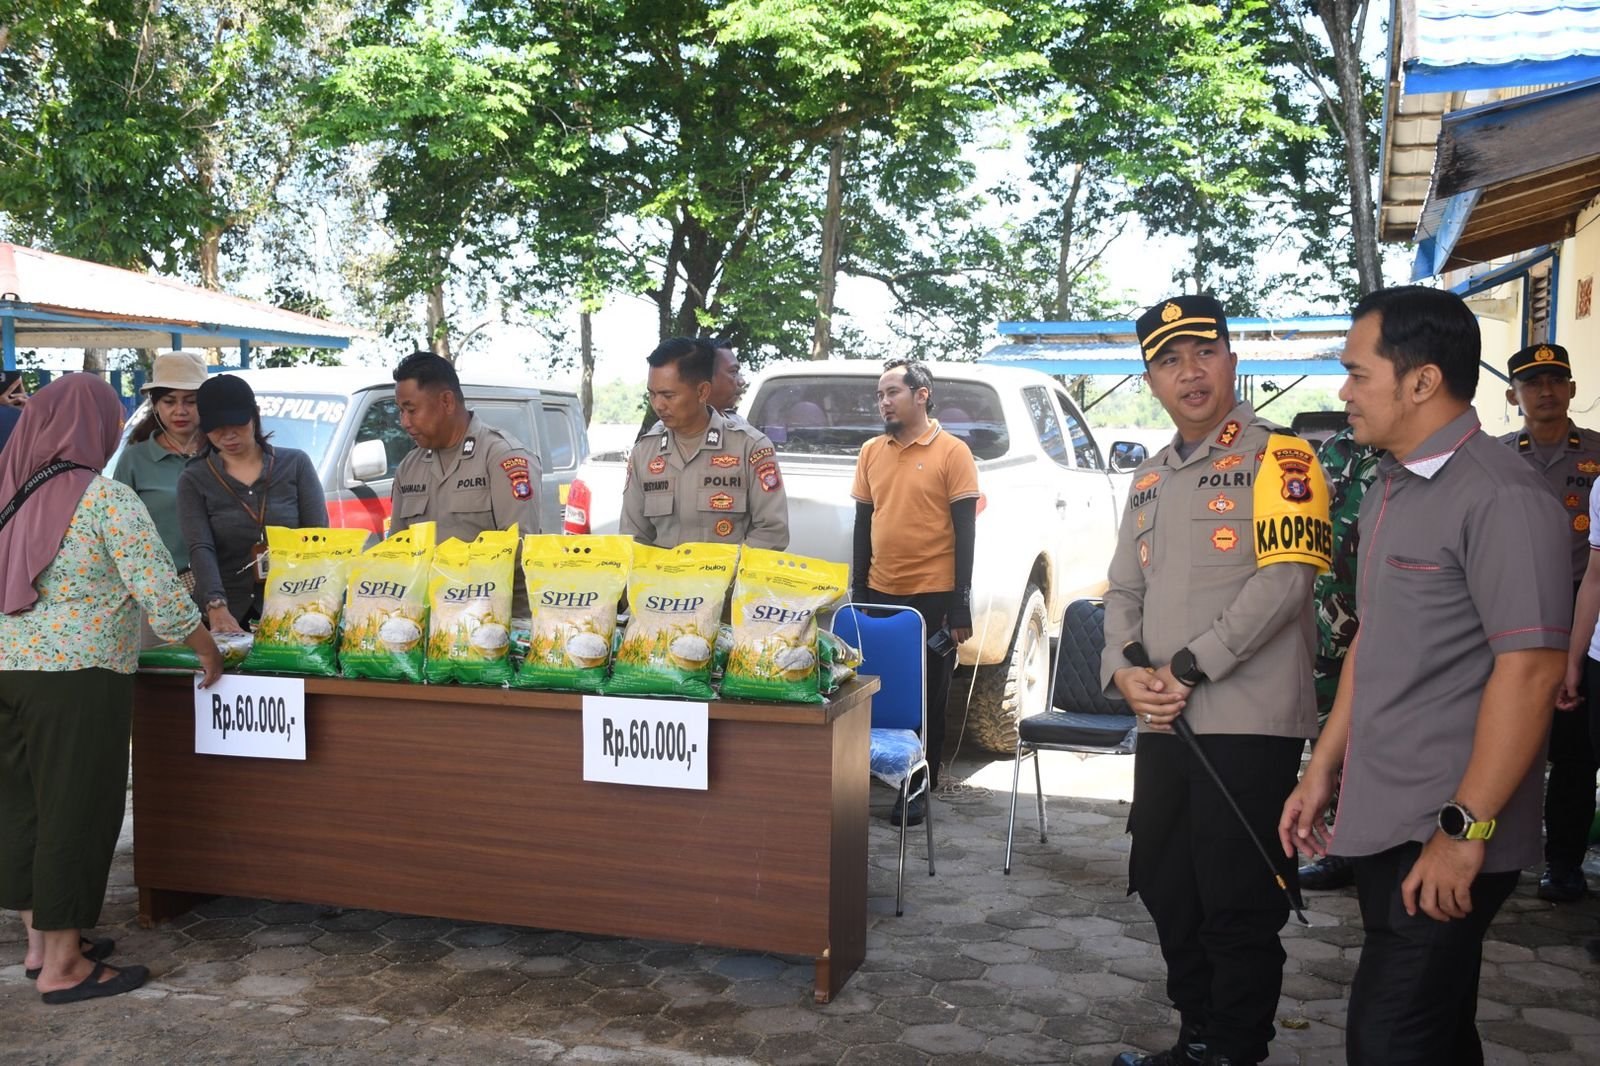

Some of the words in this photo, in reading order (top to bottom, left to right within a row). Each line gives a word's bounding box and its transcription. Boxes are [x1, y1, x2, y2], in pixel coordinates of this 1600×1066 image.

[278, 398, 346, 424] PULPIS
[456, 476, 487, 489] POLRI
[703, 476, 742, 488] POLRI
[1197, 472, 1252, 488] POLRI
[1566, 475, 1593, 488] POL
[1130, 487, 1158, 509] IQBAL
[541, 590, 599, 607] SPHP
[645, 595, 704, 611] SPHP
[752, 605, 811, 622] SPHP
[212, 693, 295, 743] Rp.60.000,-
[603, 717, 697, 772] Rp.60.000,-
